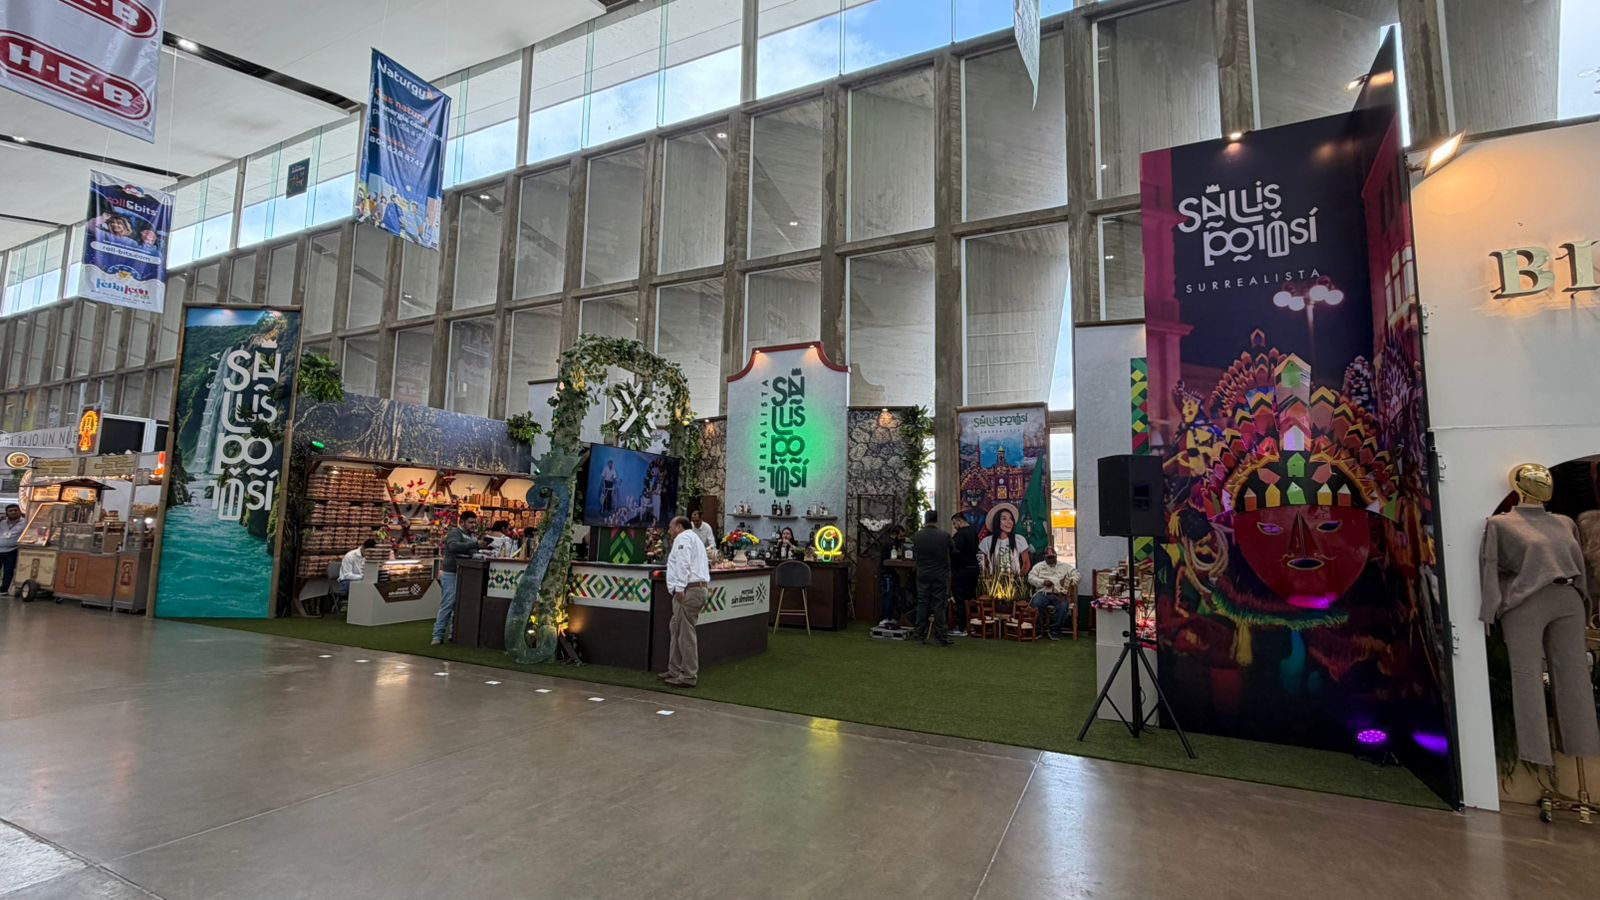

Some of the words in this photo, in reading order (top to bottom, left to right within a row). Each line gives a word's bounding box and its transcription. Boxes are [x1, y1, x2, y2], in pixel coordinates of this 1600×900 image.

[8, 42, 134, 107] H-E-B
[376, 62, 427, 100] Naturgy
[1185, 268, 1320, 294] SURREALISTA
[758, 379, 769, 495] SURREALISTA
